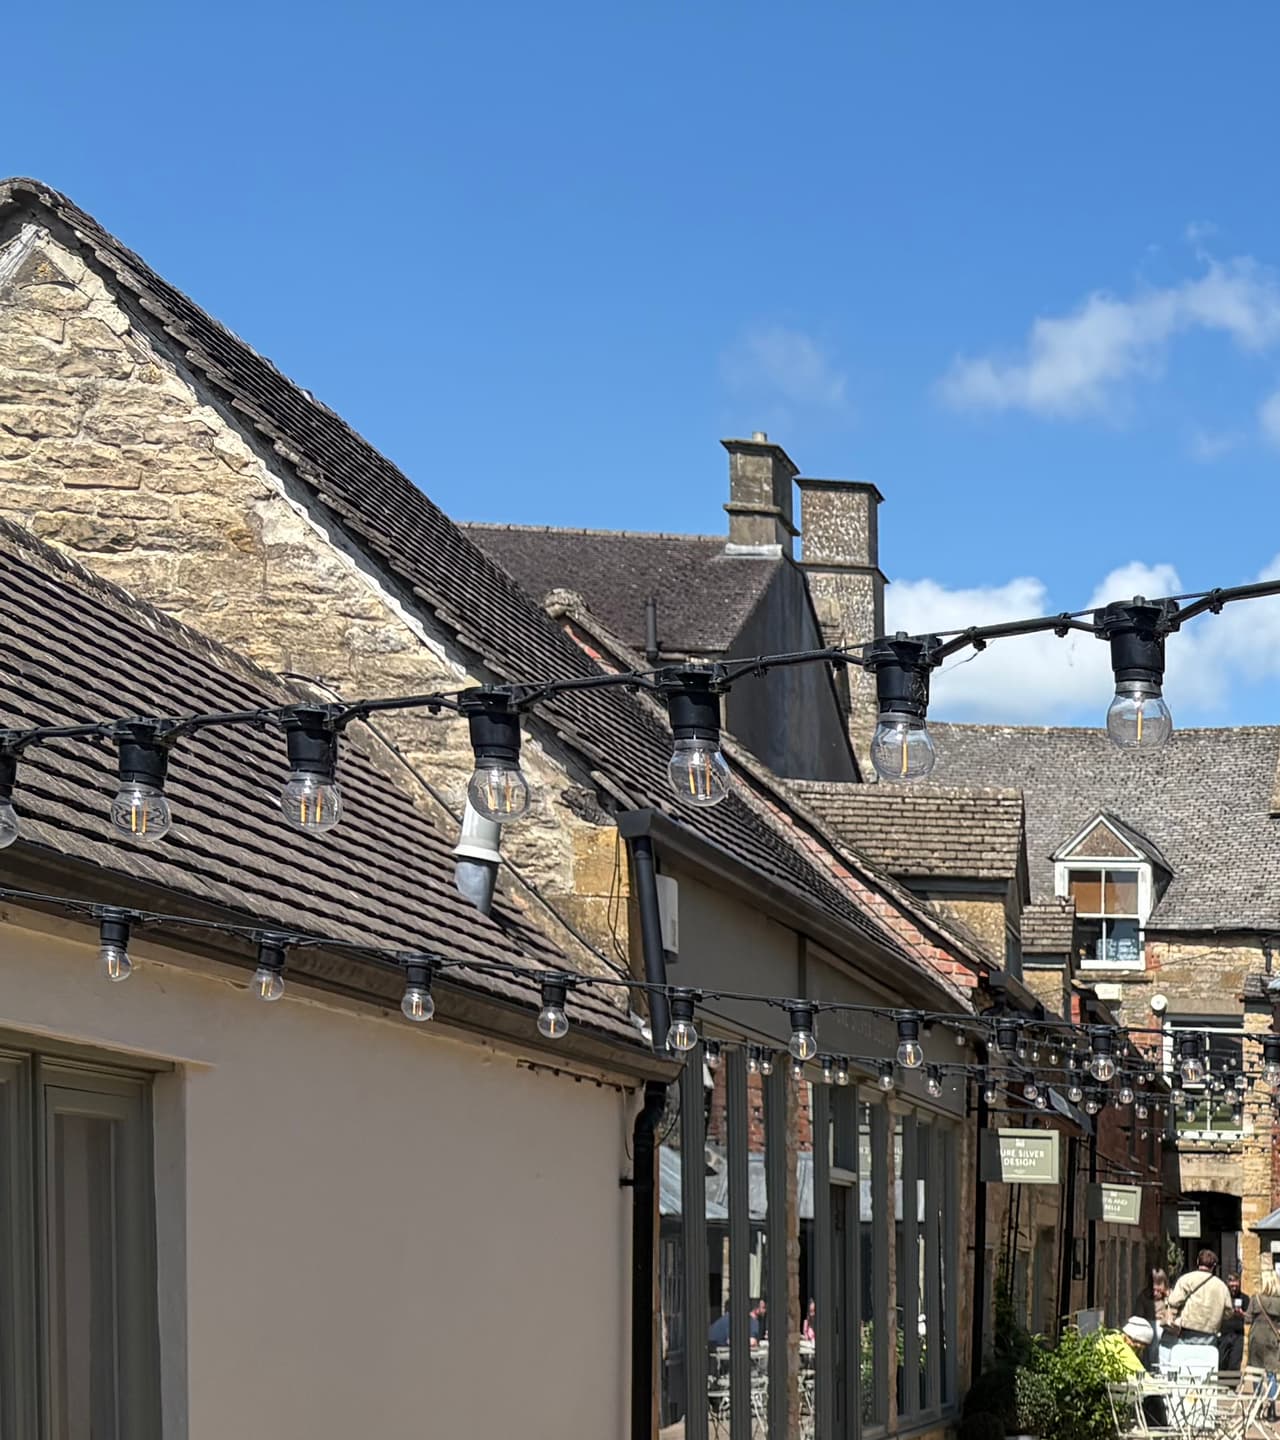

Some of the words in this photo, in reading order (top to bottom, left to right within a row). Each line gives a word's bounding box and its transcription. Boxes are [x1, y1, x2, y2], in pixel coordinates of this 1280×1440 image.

[1000, 1149, 1016, 1158] URE
[1018, 1149, 1045, 1159] SILVER
[1003, 1158, 1036, 1167] DESIGN
